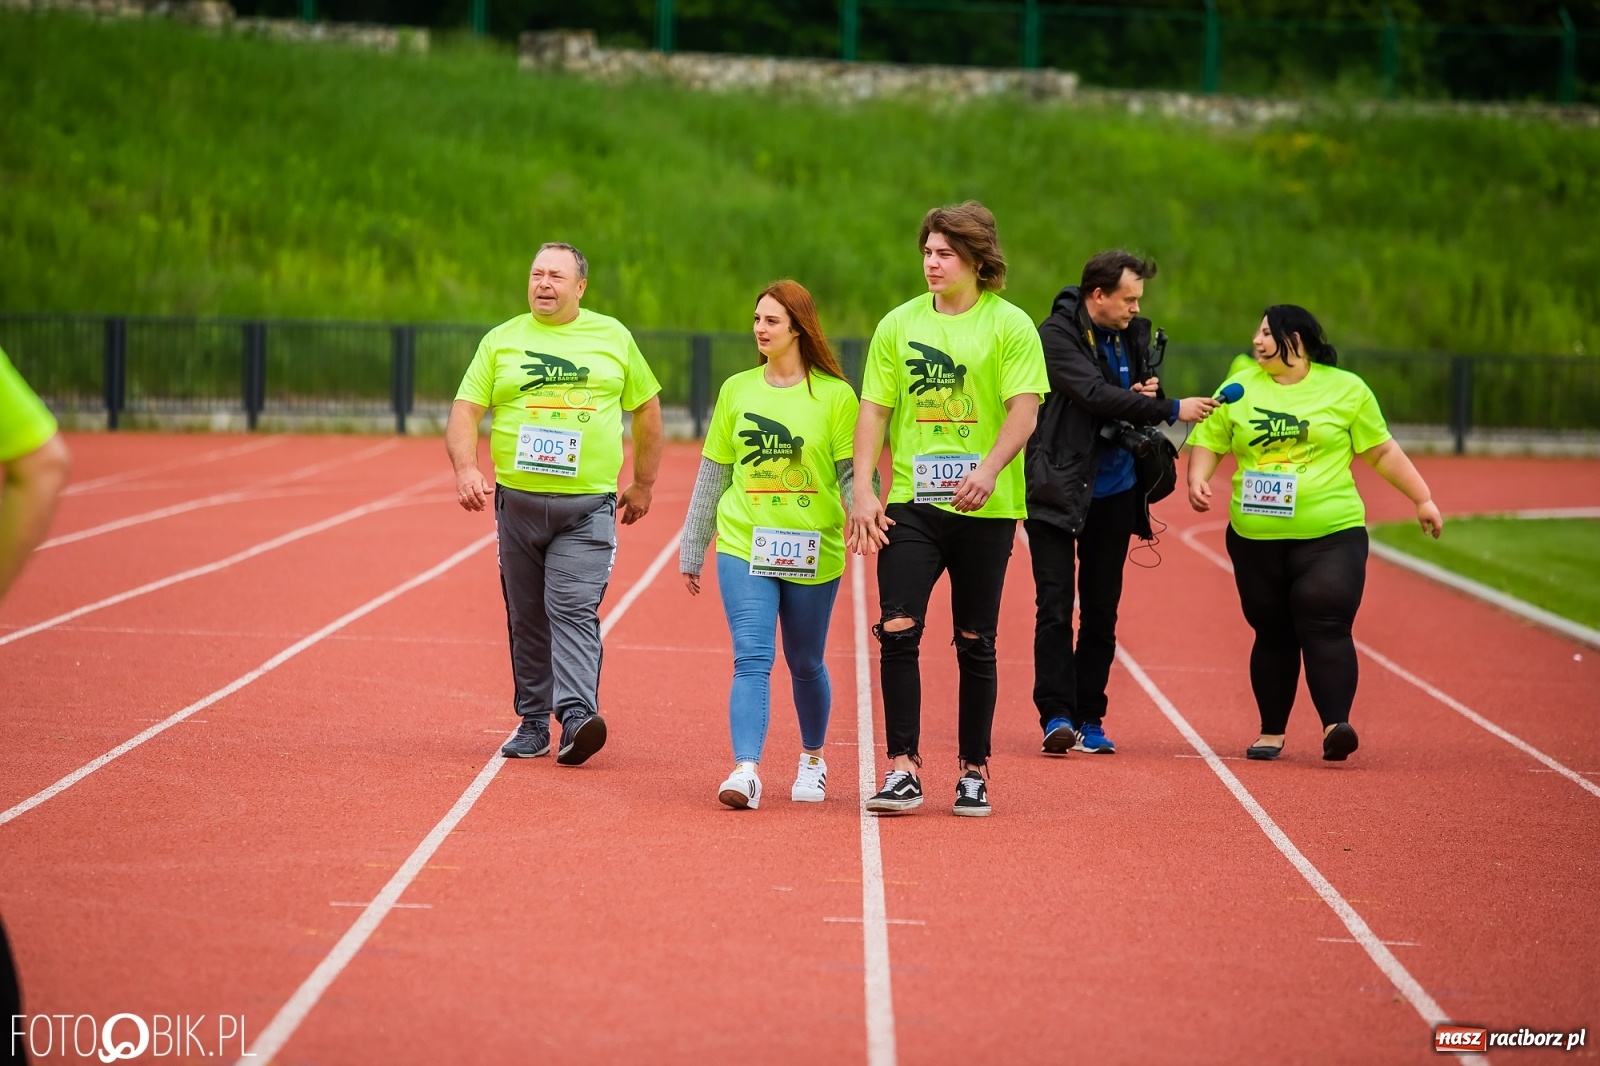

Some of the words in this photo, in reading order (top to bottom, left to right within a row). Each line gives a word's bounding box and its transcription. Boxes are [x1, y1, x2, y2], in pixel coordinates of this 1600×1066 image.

[545, 366, 562, 377] VI
[926, 363, 943, 378] VI
[1270, 419, 1286, 431] VI
[533, 438, 564, 455] 005
[569, 439, 577, 447] R
[761, 435, 778, 448] VI
[932, 463, 964, 479] 102
[1255, 480, 1281, 494] 004
[770, 541, 801, 558] 101
[809, 540, 816, 548] R
